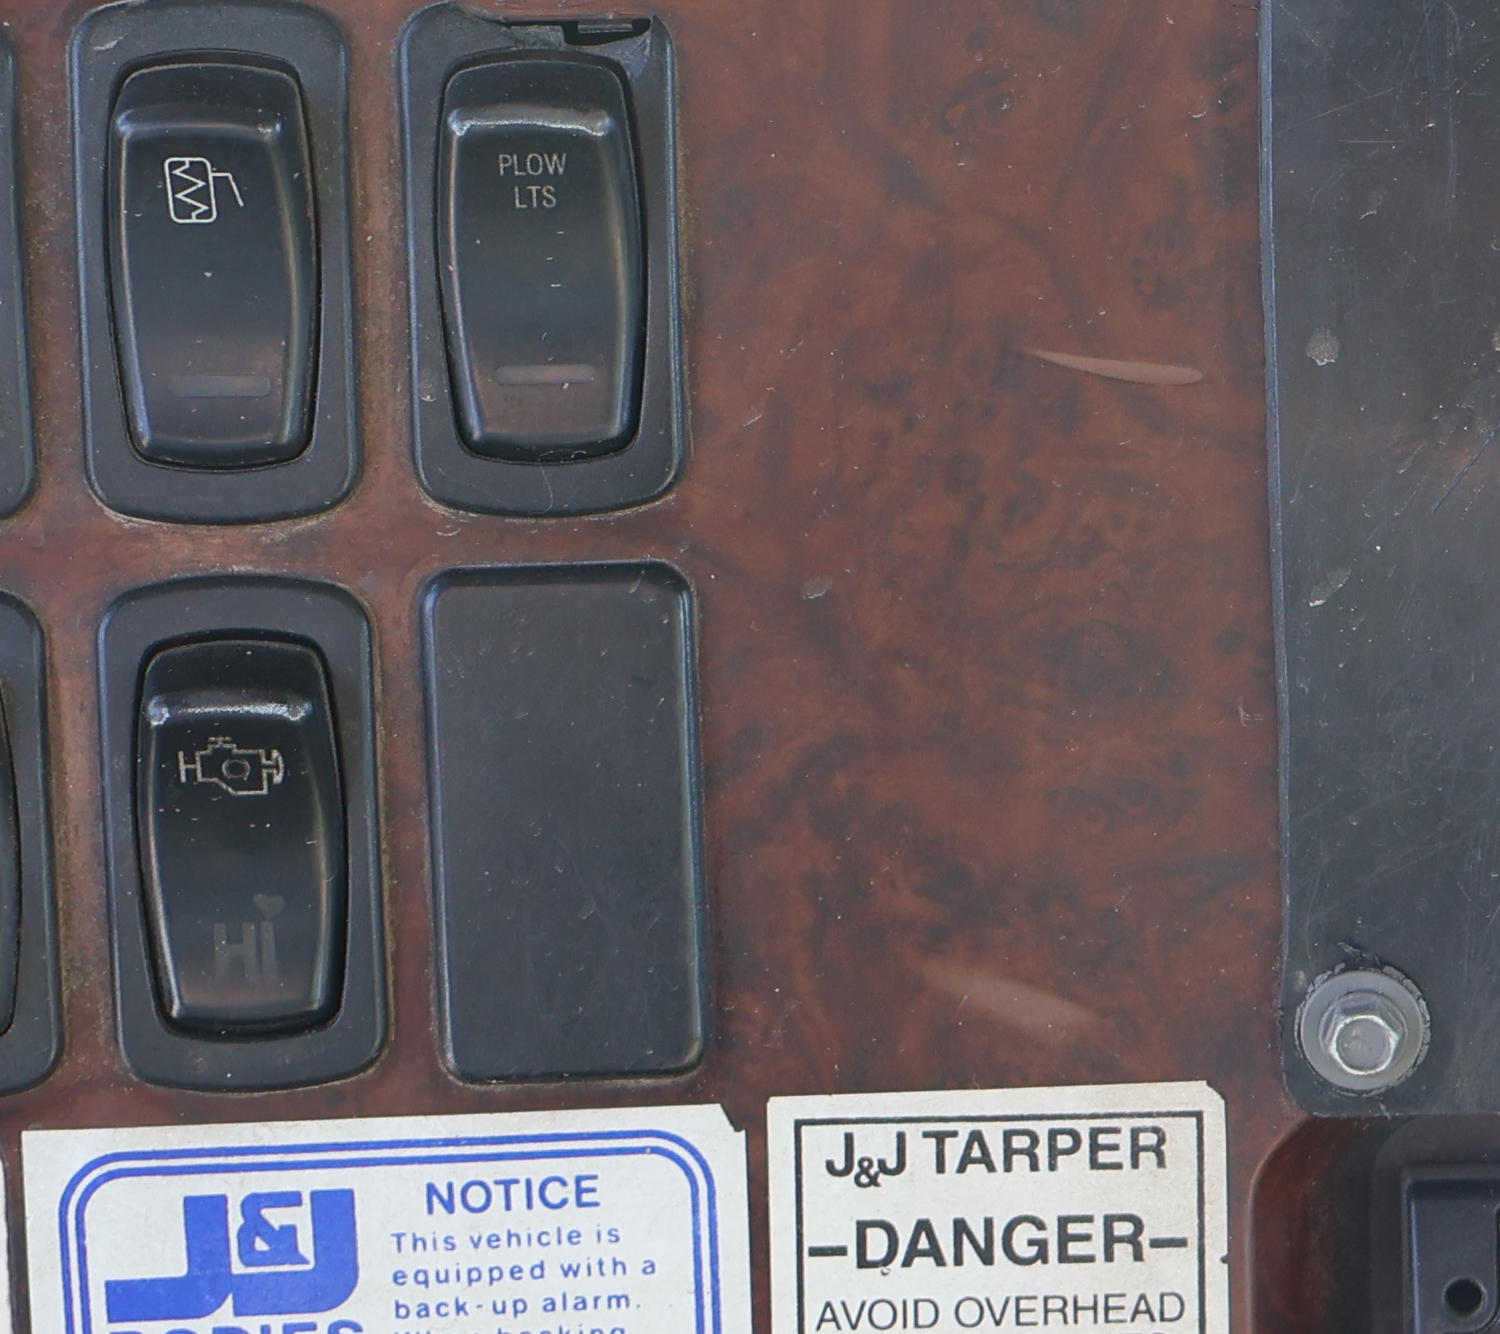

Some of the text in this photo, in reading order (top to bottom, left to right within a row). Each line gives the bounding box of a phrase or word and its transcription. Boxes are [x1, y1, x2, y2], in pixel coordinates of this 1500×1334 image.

[498, 152, 567, 177] PLOW
[514, 185, 556, 209] LTS
[825, 1125, 1167, 1188] J&J TARPER
[424, 1175, 601, 1216] NOTICE
[105, 1188, 360, 1323] J&J
[391, 1223, 622, 1254] This vehicle is
[392, 1255, 658, 1289] equipped with a
[541, 1290, 644, 1314] alarm.
[815, 1291, 1186, 1332] AVOID OVERHEAD
